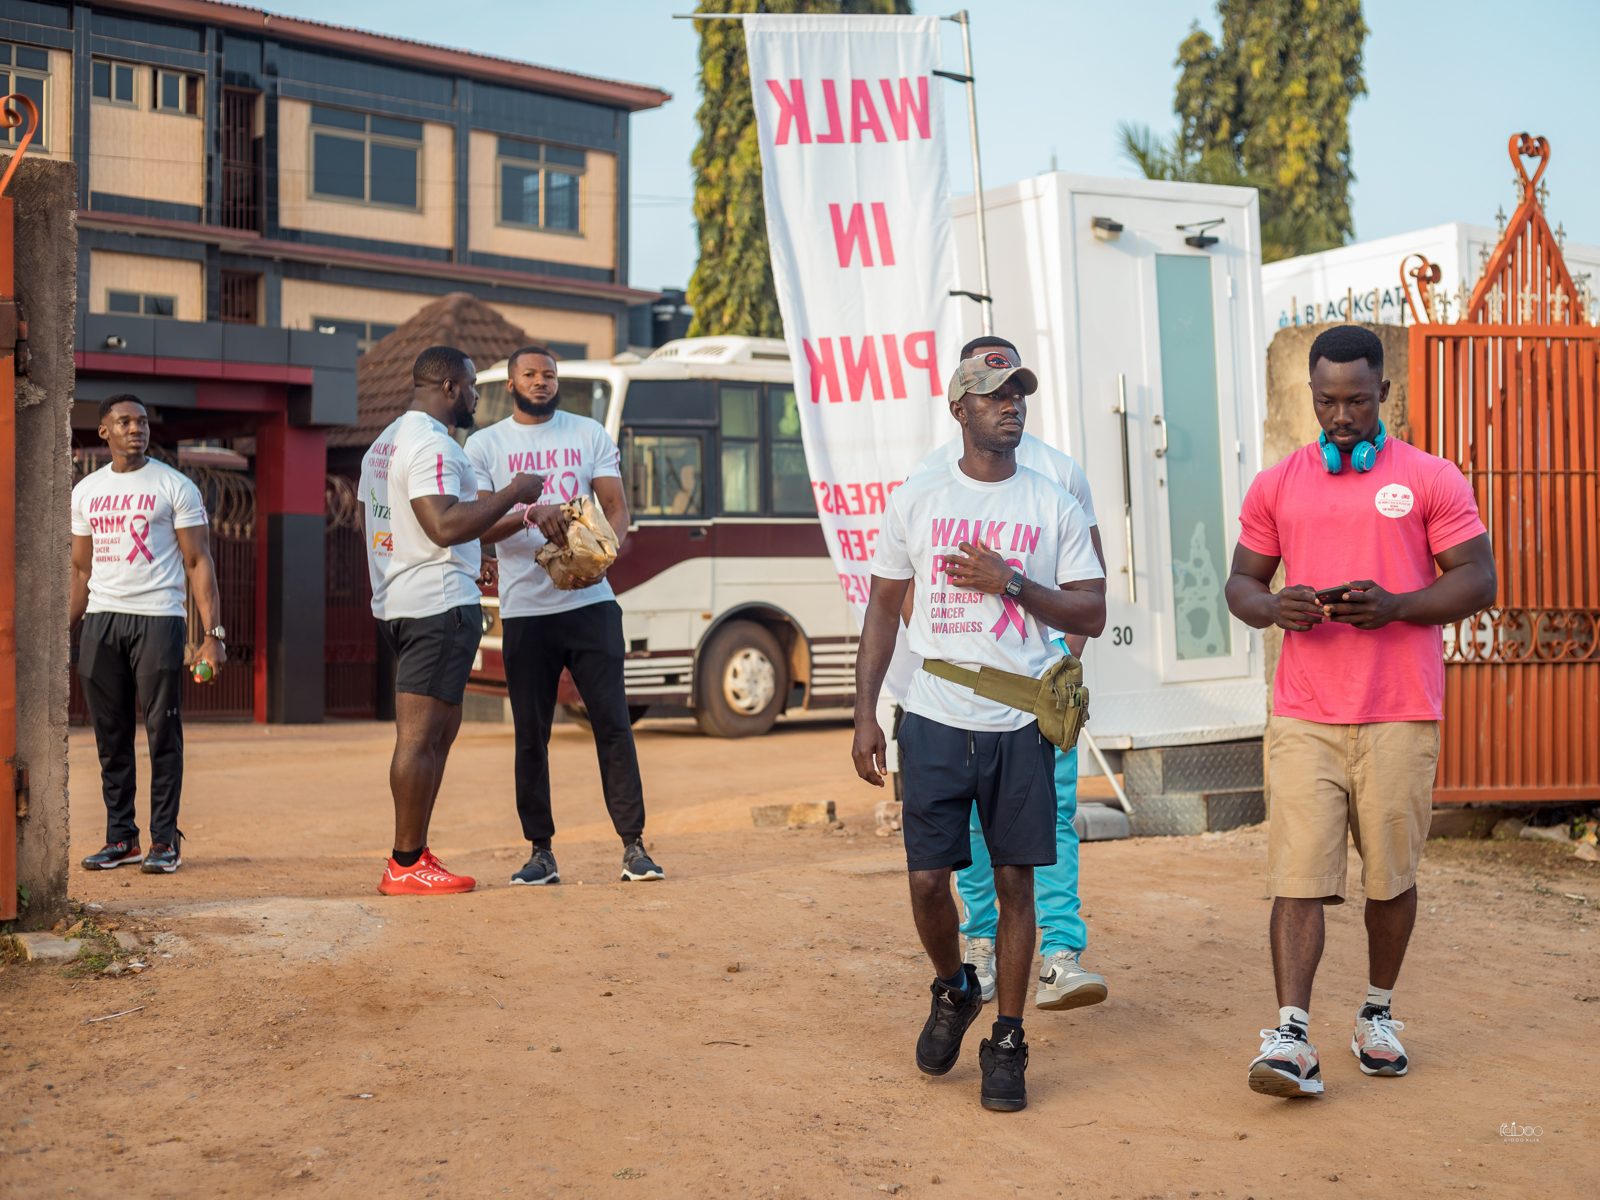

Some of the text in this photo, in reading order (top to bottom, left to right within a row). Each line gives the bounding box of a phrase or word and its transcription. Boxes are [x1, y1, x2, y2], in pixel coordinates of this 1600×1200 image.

[1305, 285, 1412, 324] BACKGAT
[508, 448, 582, 472] WALK IN
[89, 494, 156, 513] WALK IN
[90, 515, 126, 534] PINK
[1010, 523, 1041, 555] IN
[930, 592, 985, 604] FOR BREAST
[930, 607, 966, 619] CANCER
[931, 621, 984, 634] AWARENESS
[1113, 626, 1133, 646] 30
